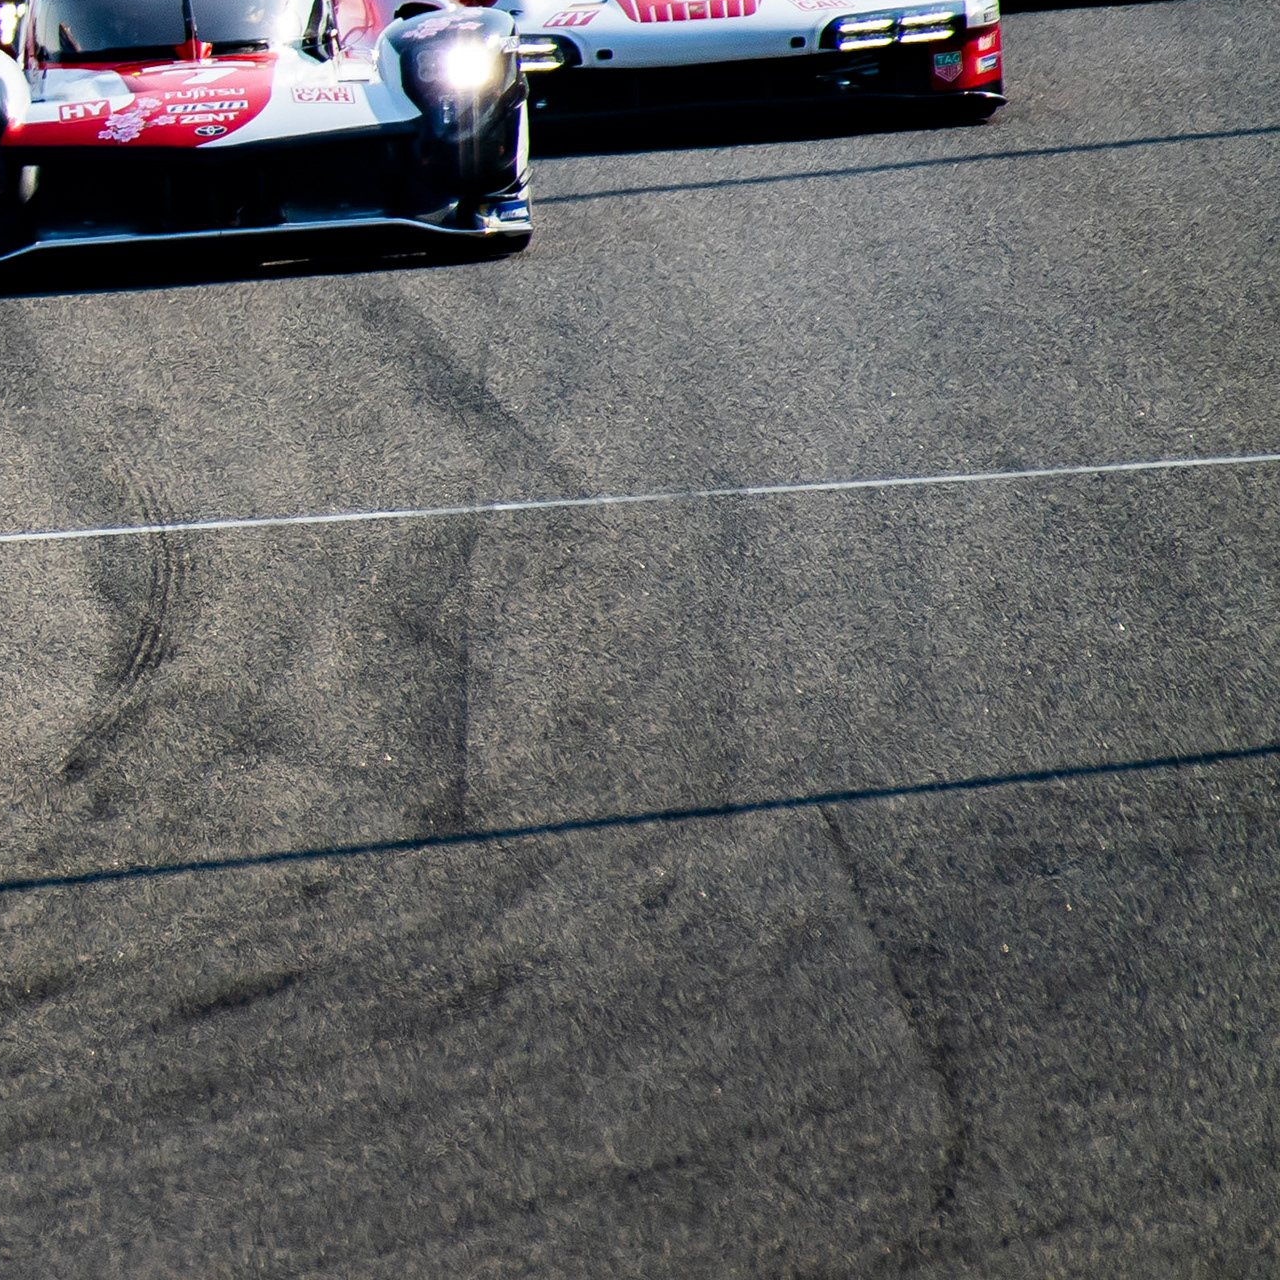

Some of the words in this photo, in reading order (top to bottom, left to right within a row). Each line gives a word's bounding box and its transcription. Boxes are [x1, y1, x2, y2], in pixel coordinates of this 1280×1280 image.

[545, 10, 598, 27] HY
[936, 53, 961, 65] TAG
[161, 68, 238, 86] 7
[164, 85, 245, 100] FUJITSU
[297, 91, 351, 102] CAR
[61, 100, 107, 122] HY
[179, 111, 239, 125] ZENT
